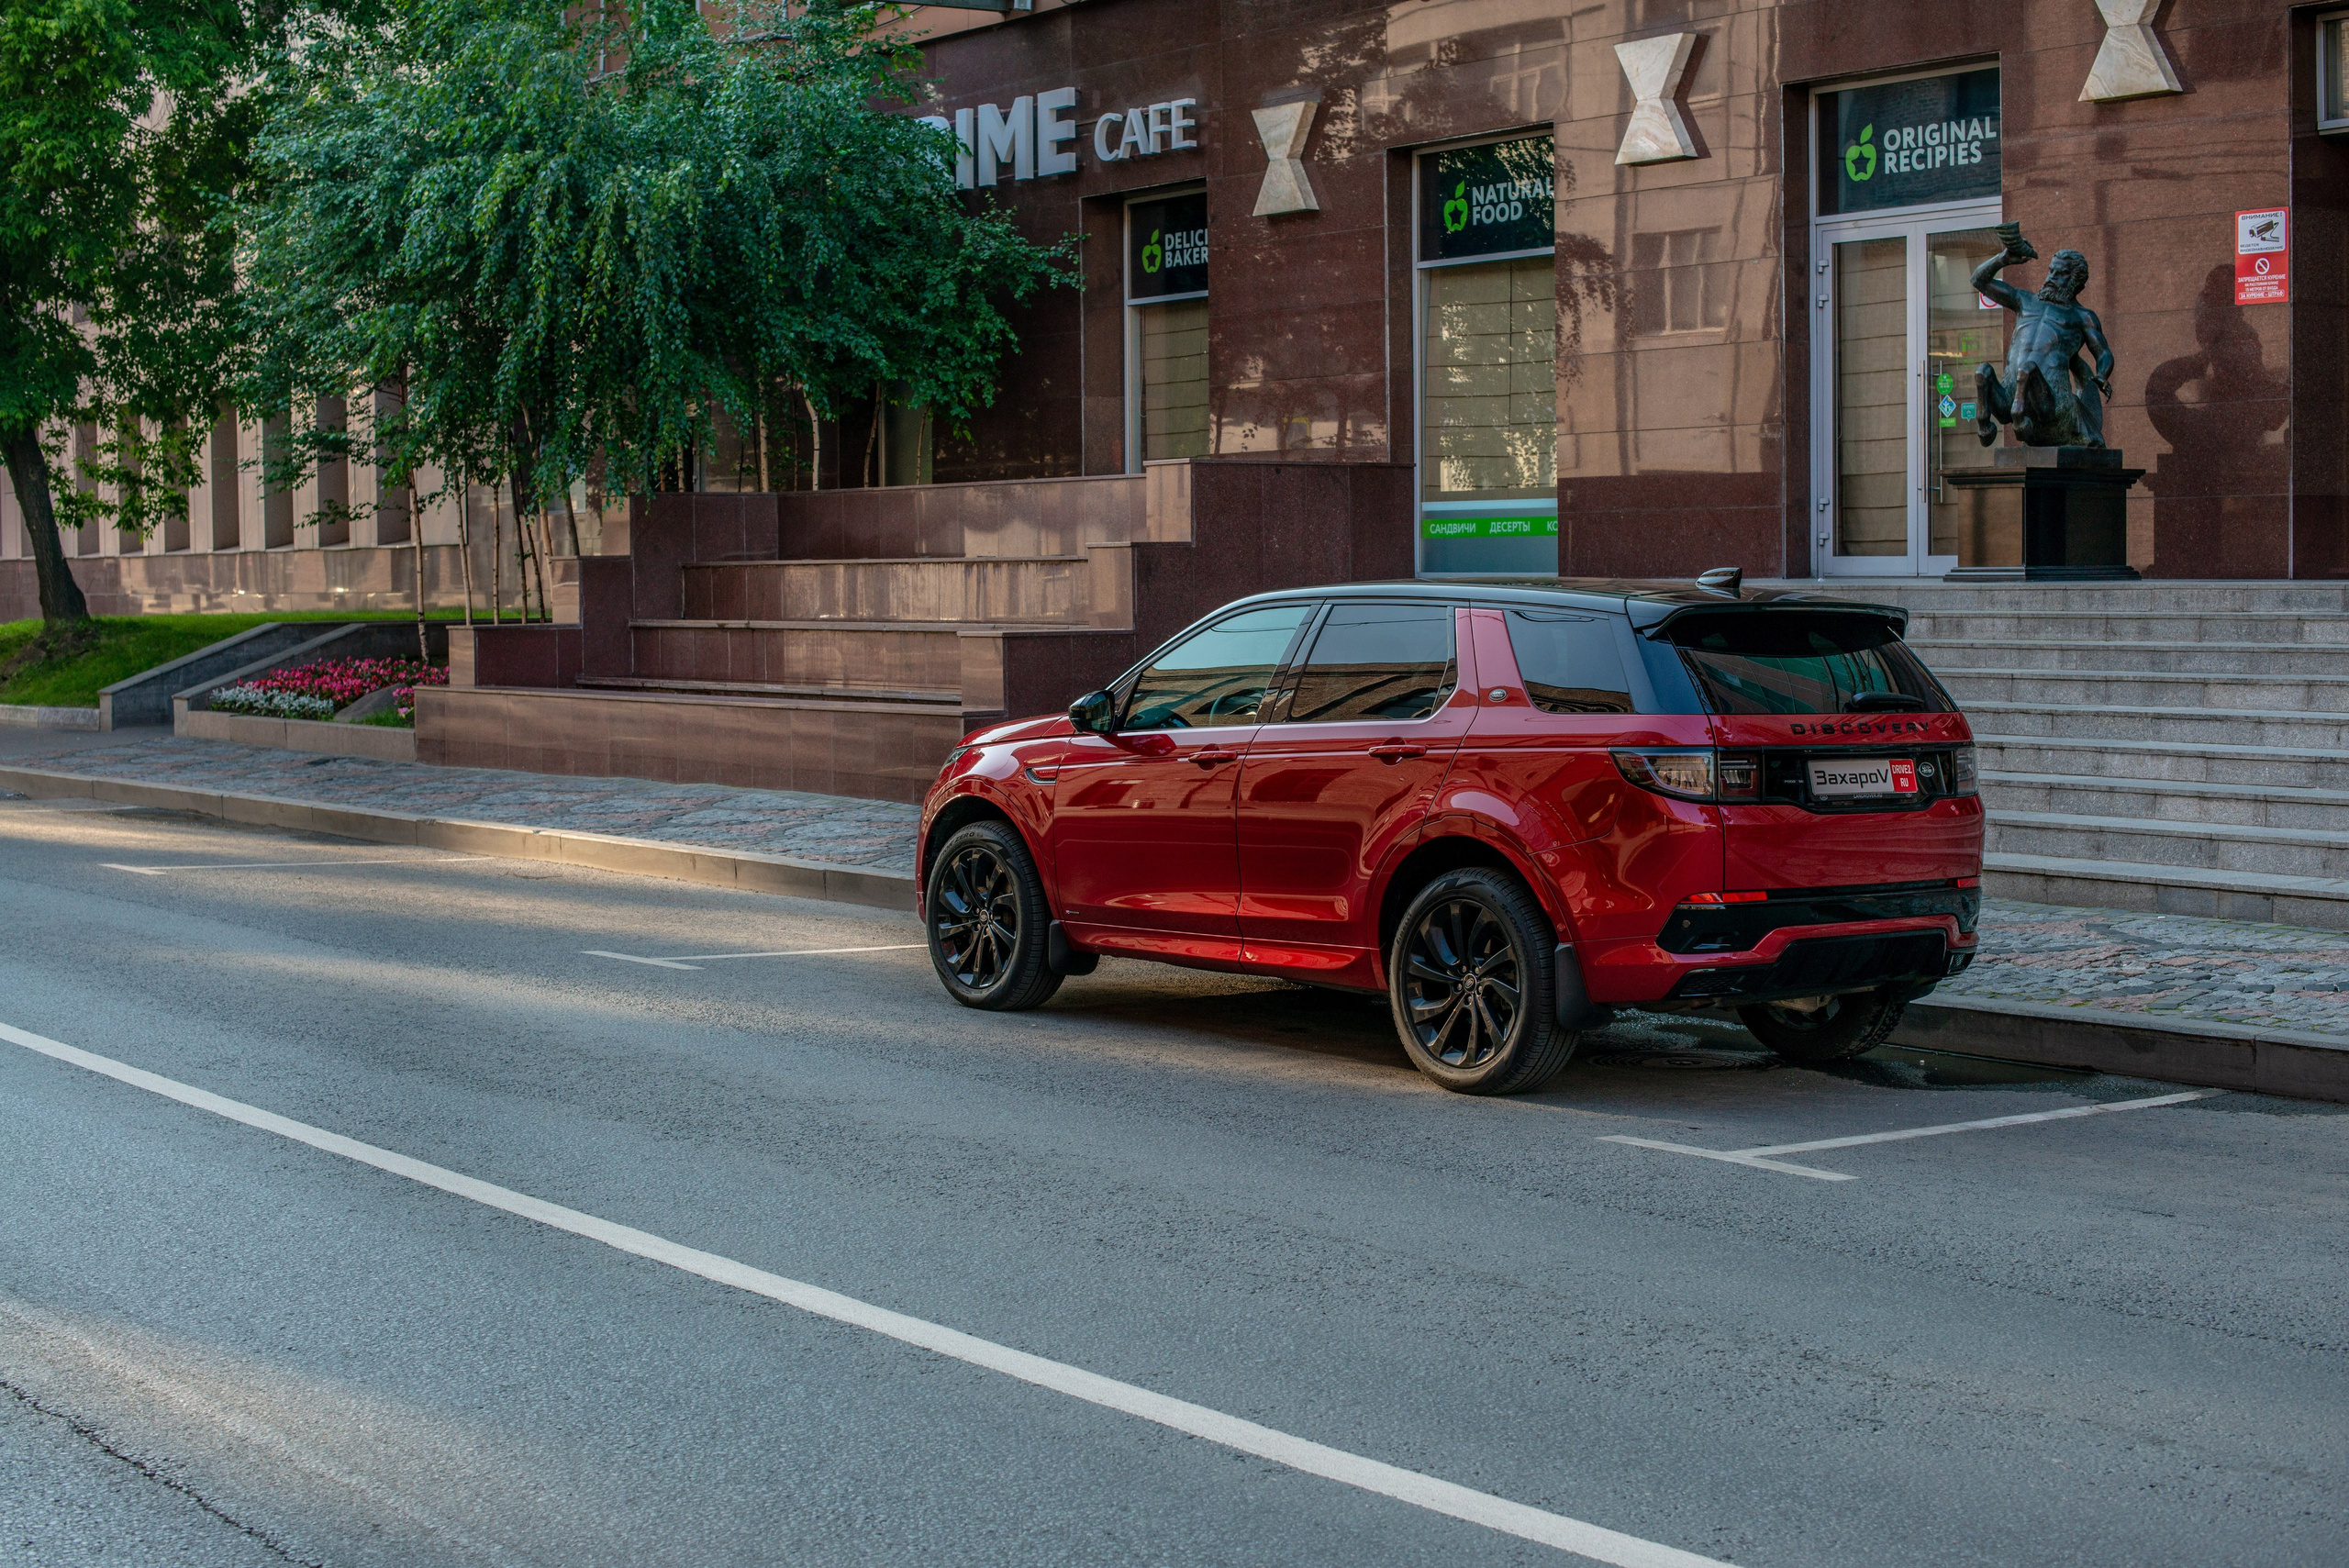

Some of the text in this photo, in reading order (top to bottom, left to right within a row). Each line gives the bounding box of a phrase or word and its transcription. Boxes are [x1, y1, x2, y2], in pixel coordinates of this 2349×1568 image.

[1094, 97, 1197, 161] CAFE
[1883, 116, 1998, 151] ORIGINAL
[1884, 140, 1983, 174] RECIPIES
[1472, 176, 1554, 206] NATURAL
[1472, 201, 1523, 226] FOOD
[2241, 212, 2283, 221] ВНИМАНИЕ!
[1430, 523, 1476, 535] САНДВИЧИ
[1489, 521, 1531, 534] ДЕСЕРТЫ
[1790, 722, 1929, 735] DISCOVERY
